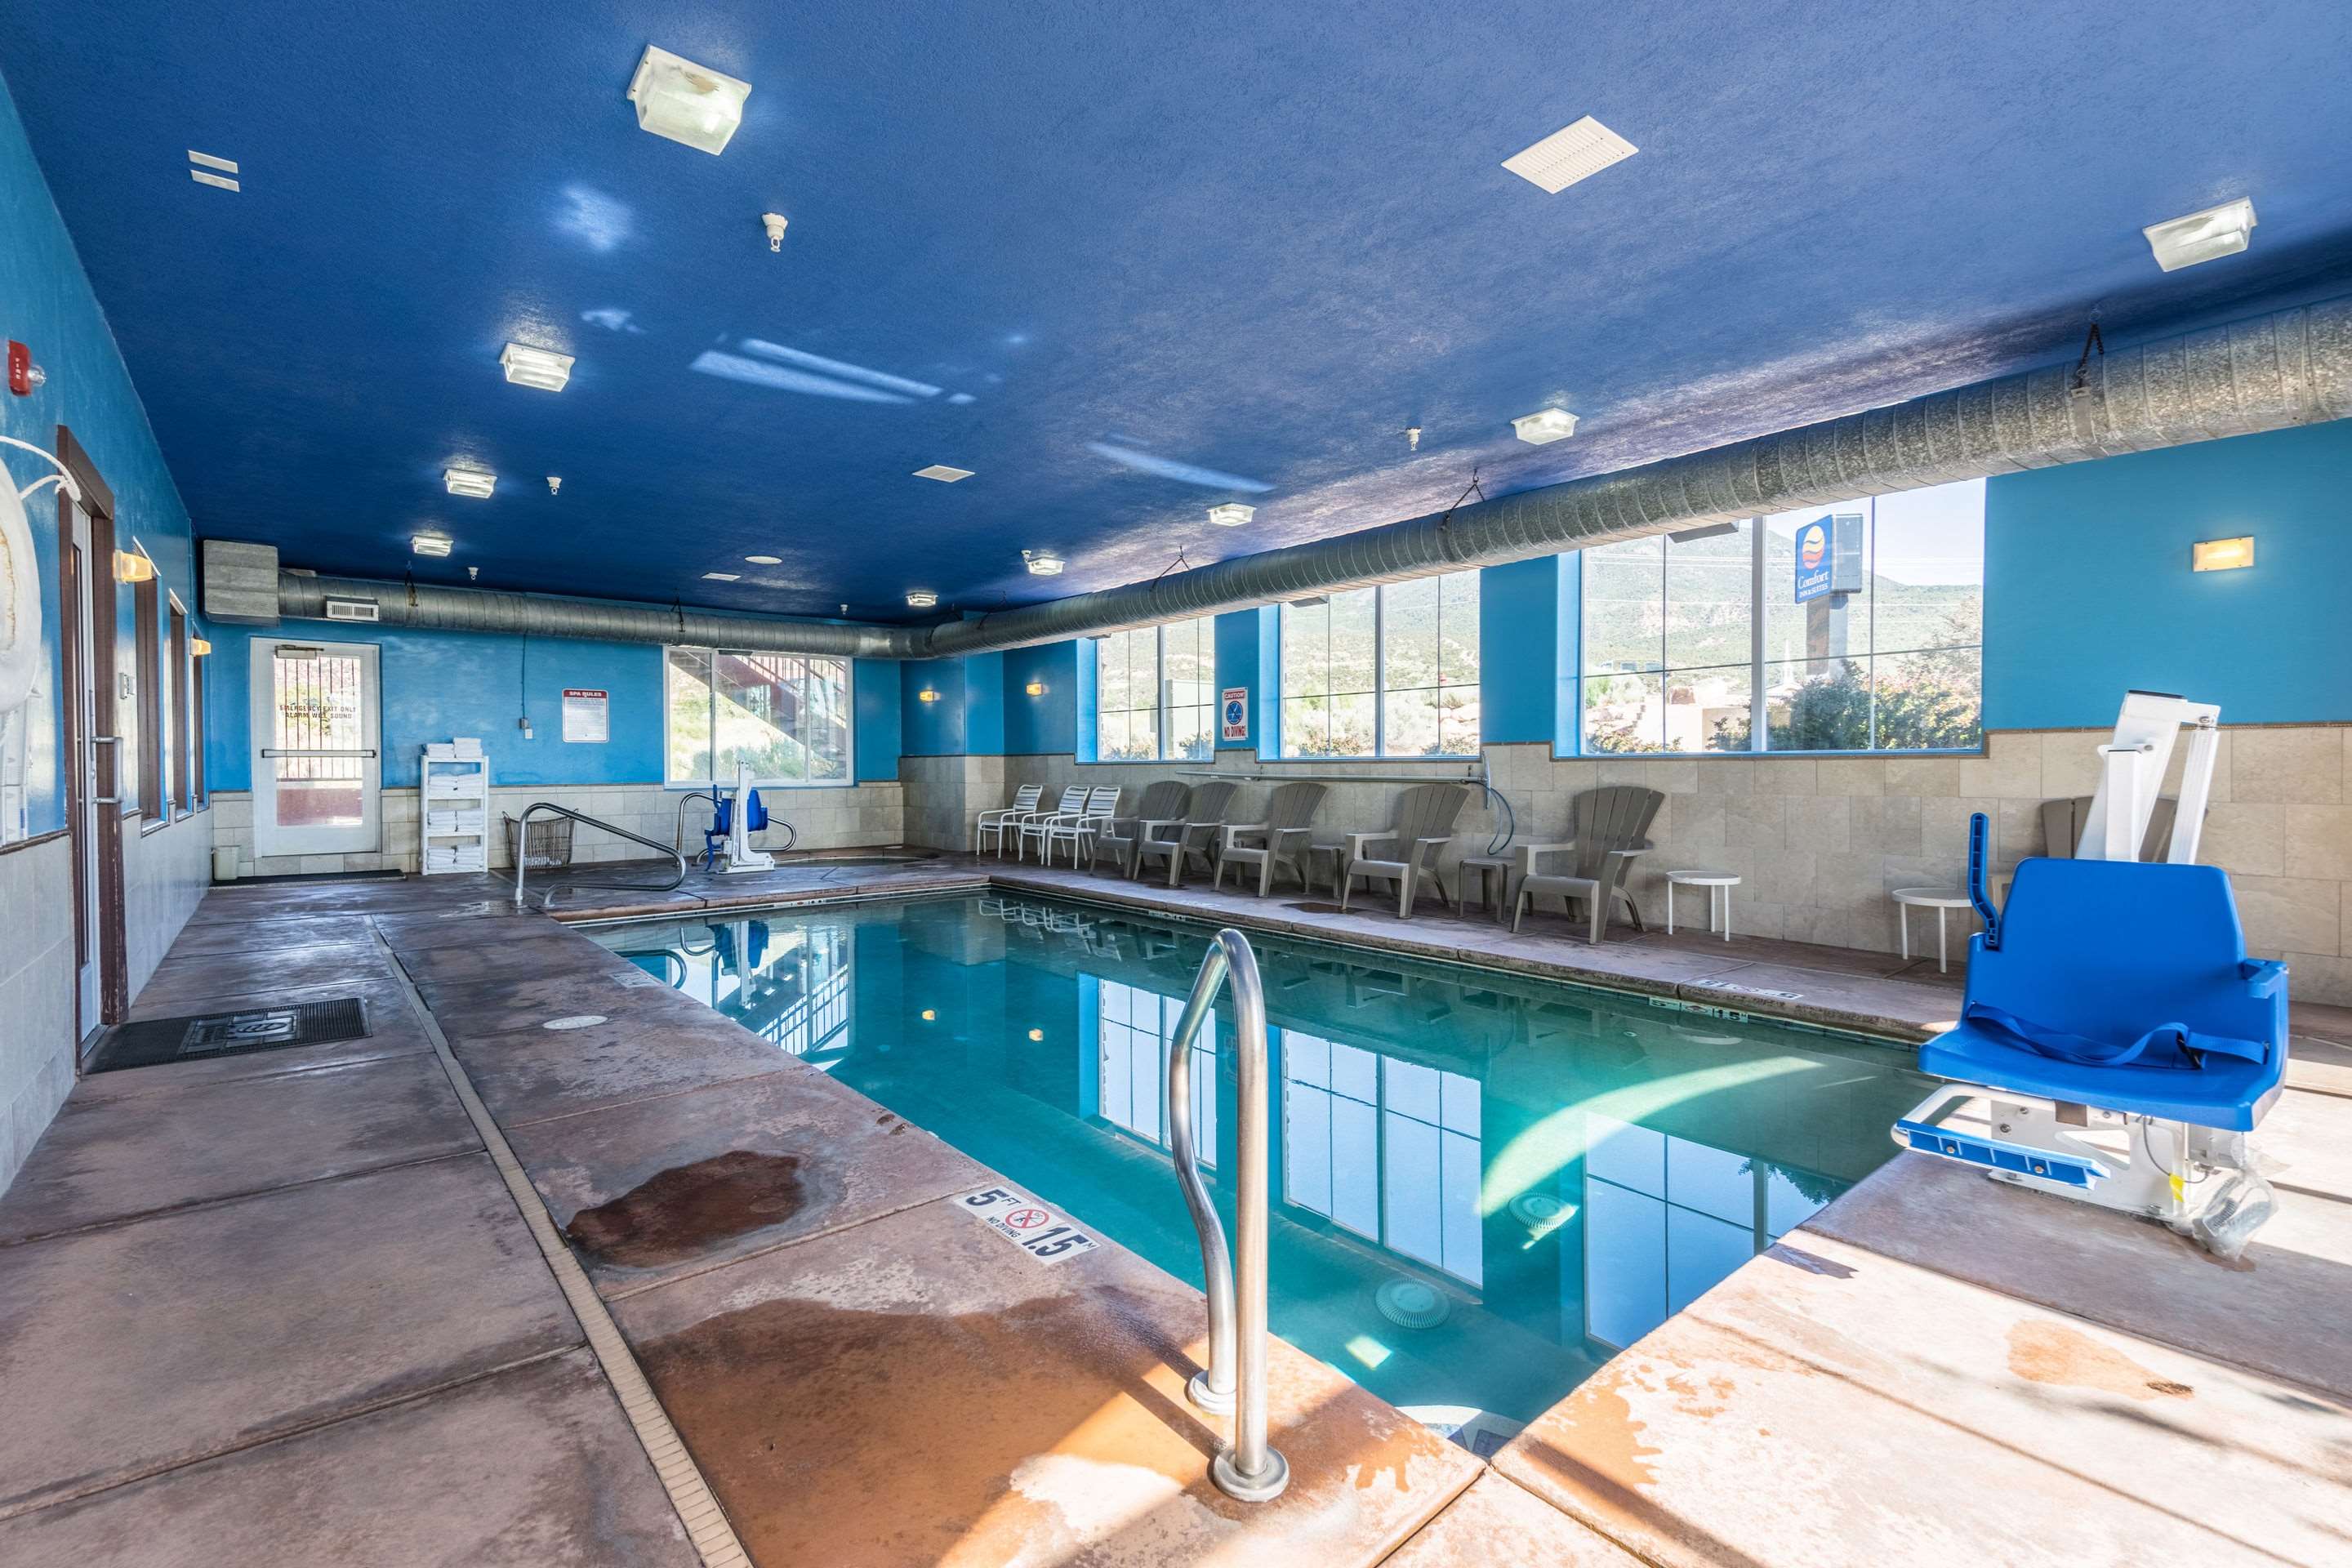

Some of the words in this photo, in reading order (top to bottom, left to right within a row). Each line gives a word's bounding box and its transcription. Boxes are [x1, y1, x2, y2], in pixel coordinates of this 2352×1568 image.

[1797, 569, 1829, 589] Comfort
[1224, 726, 1230, 737] NO
[965, 1188, 1009, 1206] 5
[1000, 1197, 1022, 1206] FT
[996, 1223, 1021, 1237] DIVING
[1022, 1227, 1089, 1257] 1.5
